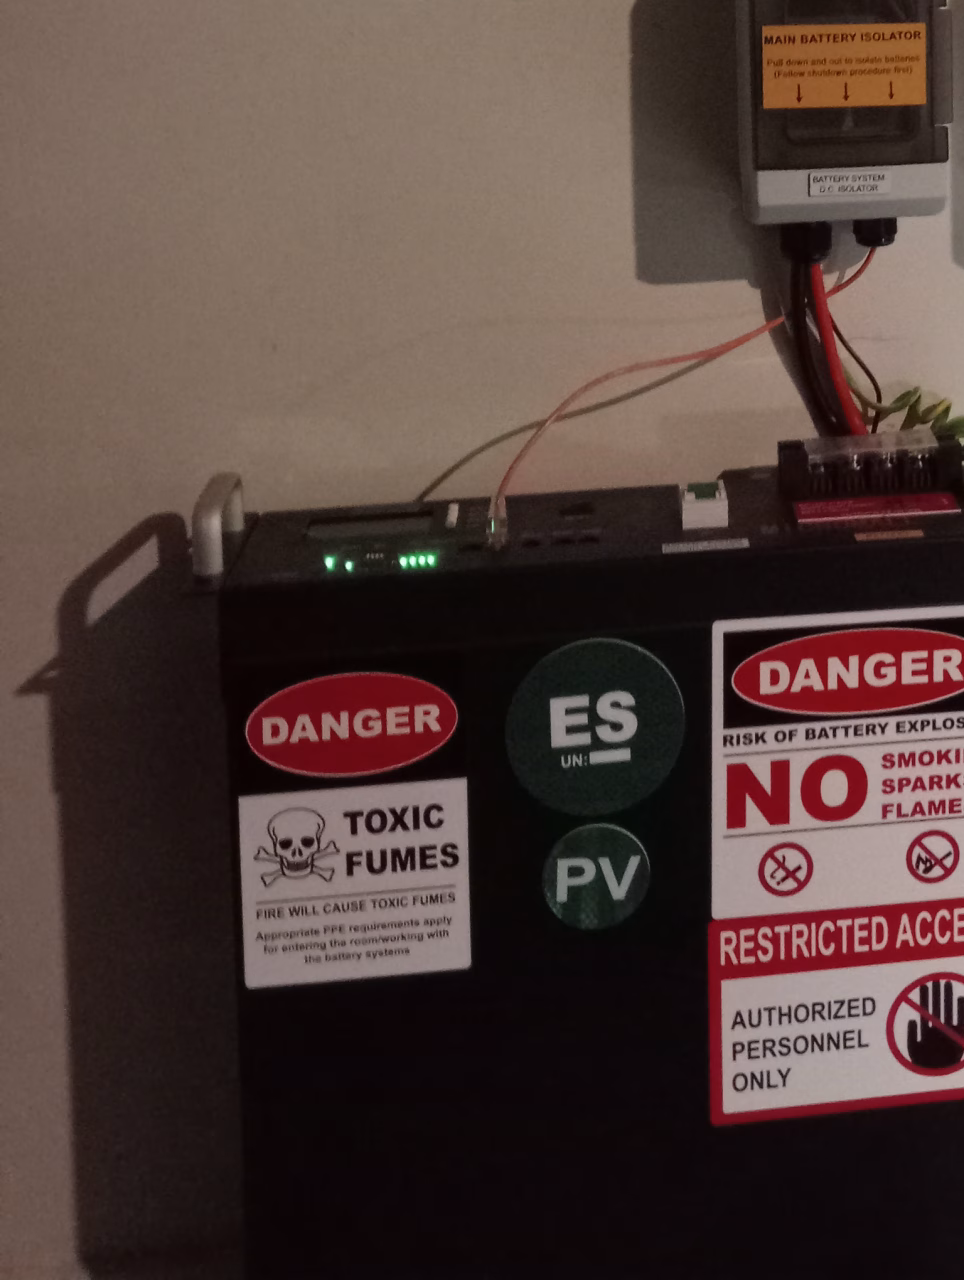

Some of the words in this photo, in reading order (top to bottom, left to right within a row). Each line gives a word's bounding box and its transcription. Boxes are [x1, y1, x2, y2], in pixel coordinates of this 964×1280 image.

[763, 35, 796, 45] MAIN
[800, 33, 856, 44] BATTERY
[861, 31, 921, 42] ISOLATOR
[774, 69, 805, 79] (Follow
[808, 67, 847, 77] shutdown
[850, 66, 890, 77] procedure
[786, 57, 808, 66] down
[811, 56, 826, 66] and
[829, 56, 843, 65] out
[813, 175, 849, 183] BATTERY
[851, 174, 885, 182] SYSTEM
[838, 184, 878, 192] ISOLATOR
[759, 648, 964, 695] DANGER
[262, 704, 441, 746] DANGER
[550, 690, 638, 748] ES
[723, 731, 767, 747] RISK
[774, 729, 798, 743] OF
[805, 722, 890, 741] BATTERY
[726, 754, 868, 829] NO
[343, 803, 444, 835] TOXIC
[345, 842, 460, 876] FUMES
[556, 855, 641, 903] PV
[256, 907, 284, 919] FIRE
[289, 904, 319, 918] WILL
[323, 900, 365, 914] CAUSE
[372, 897, 408, 909] TOXIC
[412, 892, 456, 906] FUMES
[256, 929, 320, 942] Appropriate
[349, 919, 420, 933] requirements
[423, 916, 452, 927] apply
[263, 944, 278, 955] for
[282, 940, 327, 952] entering
[330, 938, 347, 948] the
[350, 932, 424, 946] room/working
[427, 929, 450, 939] with
[720, 916, 889, 966] RESTRICTED
[304, 955, 321, 964] the
[325, 950, 363, 962] battery
[366, 947, 411, 959] systems
[731, 997, 876, 1030] AUTHORIZED
[732, 1030, 869, 1061] PERSONNEL
[732, 1068, 791, 1092] ONLY
